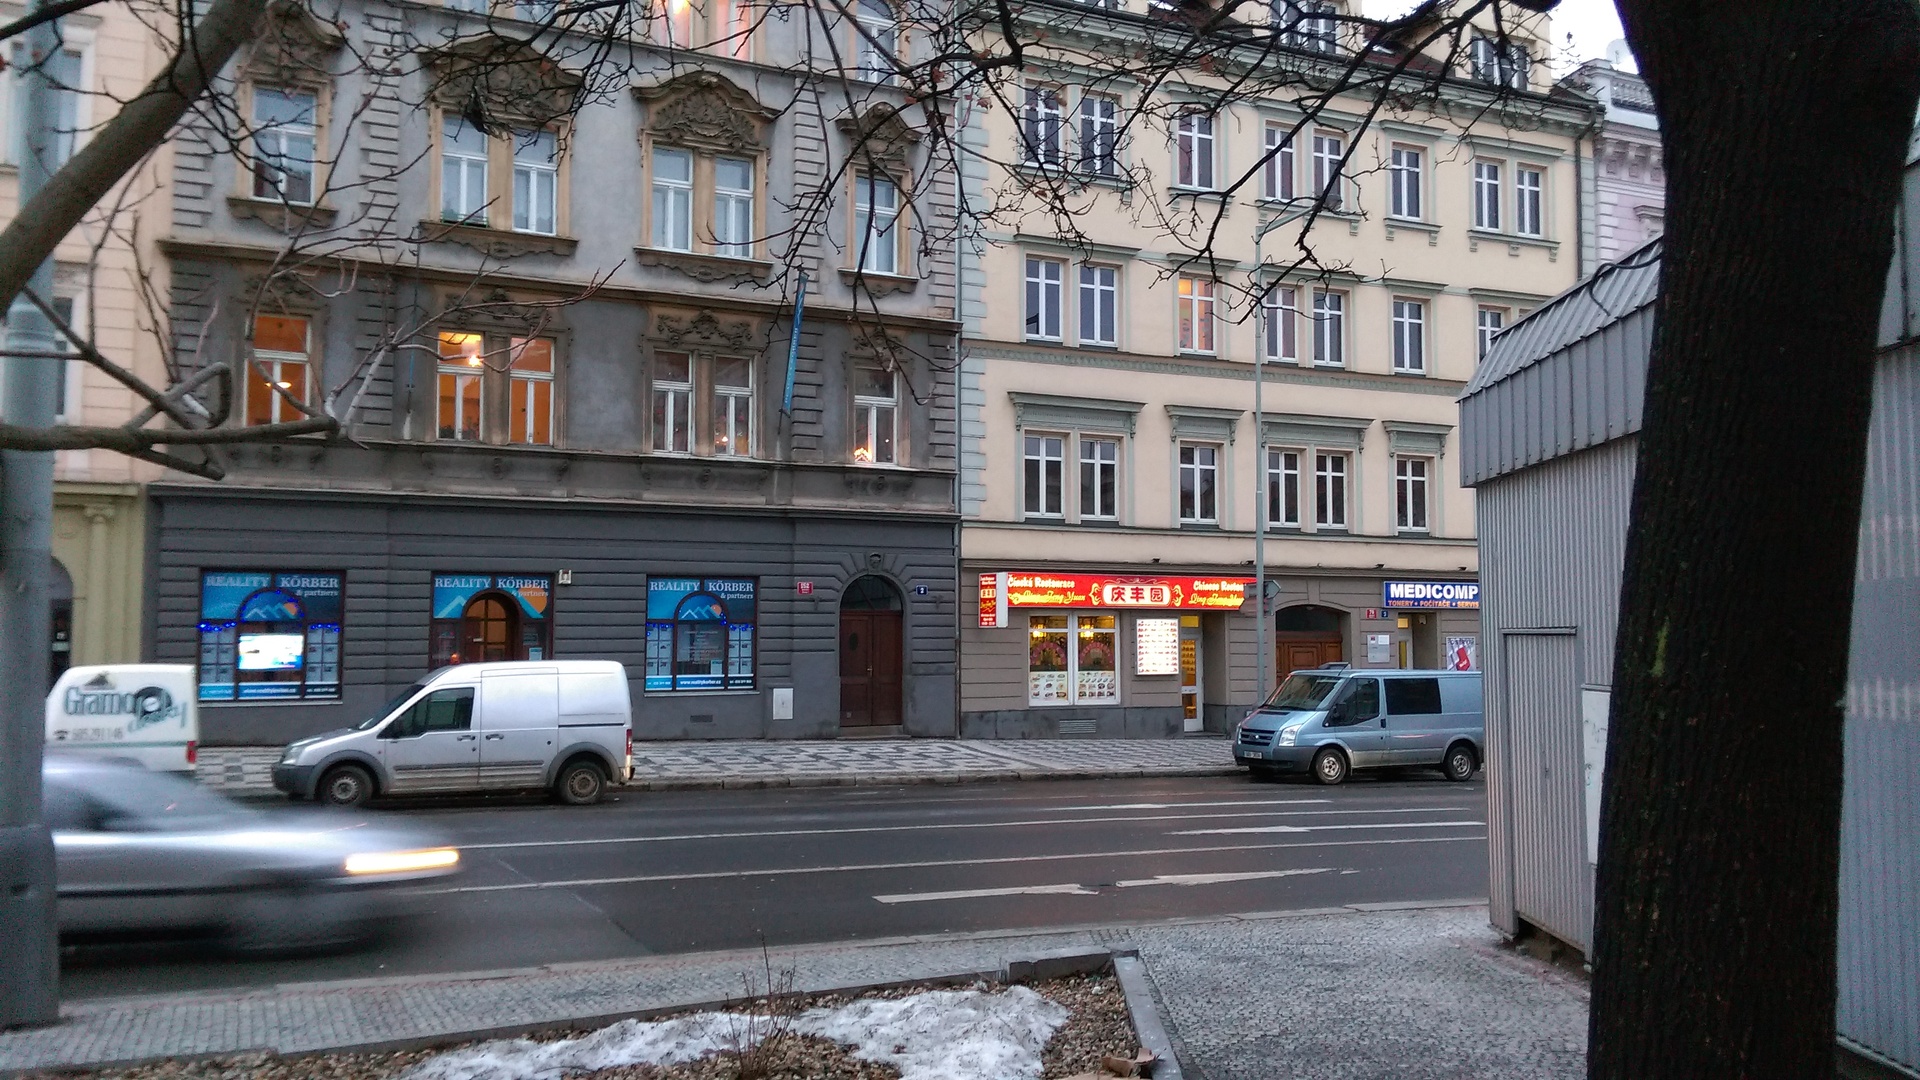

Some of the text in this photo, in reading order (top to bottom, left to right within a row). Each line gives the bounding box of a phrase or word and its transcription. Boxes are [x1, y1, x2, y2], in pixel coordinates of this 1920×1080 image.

[206, 576, 338, 588] REALITY KÖRBER
[435, 576, 549, 589] REALITY KÖRBER
[650, 580, 754, 592] REALITY KÖRBER
[1193, 580, 1220, 591] Chinese
[304, 590, 338, 598] partners
[519, 590, 549, 598] partners
[1111, 586, 1164, 603] 庆丰园
[1390, 583, 1479, 599] MEDICOMP
[1420, 599, 1451, 607] POČÍTAČE
